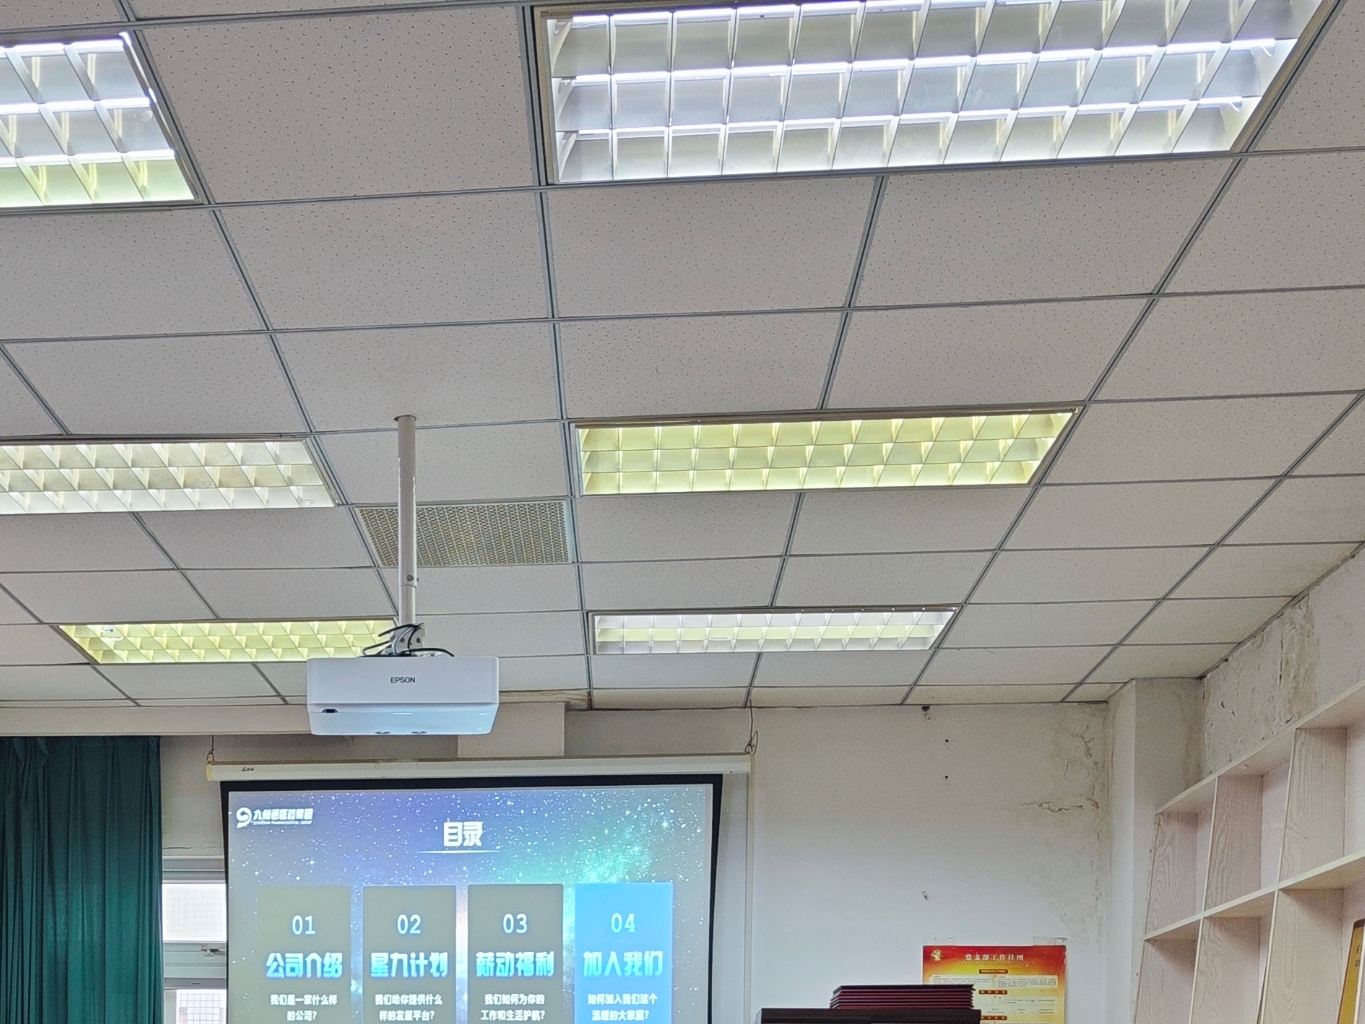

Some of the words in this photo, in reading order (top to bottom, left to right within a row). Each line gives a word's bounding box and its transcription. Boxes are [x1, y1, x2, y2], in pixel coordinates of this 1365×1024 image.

[443, 821, 483, 847] 目录
[292, 915, 316, 935] 01
[397, 914, 421, 935] 02
[503, 913, 528, 934] 03
[611, 912, 636, 933] 04
[265, 952, 343, 979] 公司介绍
[370, 951, 448, 978] 星九计划
[475, 951, 555, 977] 薪动福利
[583, 950, 663, 977] 加入我们
[270, 994, 338, 1006] 我们是一家什么样
[375, 994, 443, 1006] 我们给你提供什么
[484, 994, 545, 1005] 我们如何为你的
[588, 993, 658, 1005] 如何加入我们这个
